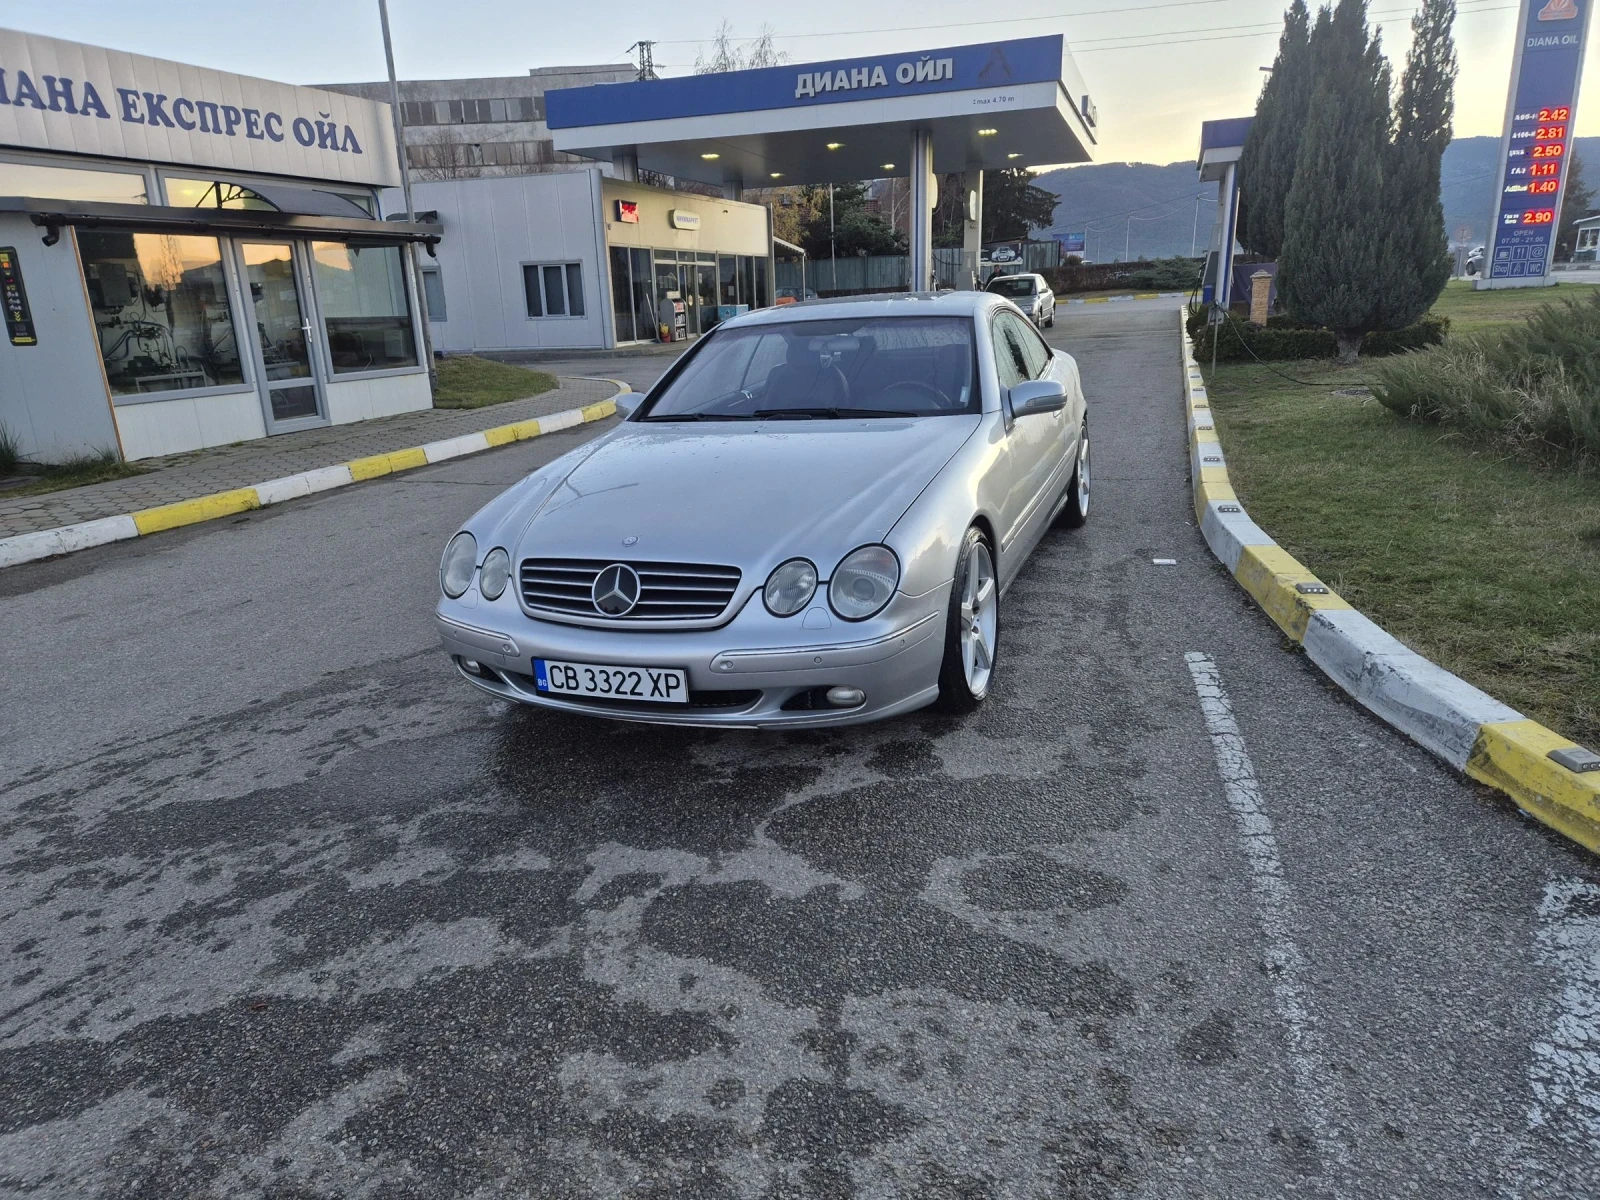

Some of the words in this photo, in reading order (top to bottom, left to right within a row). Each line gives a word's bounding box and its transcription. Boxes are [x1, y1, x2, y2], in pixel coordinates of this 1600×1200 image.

[1527, 36, 1559, 47] DIANA
[1561, 34, 1579, 45] OIL
[795, 65, 889, 98] ДИАНА
[895, 55, 953, 84] ОЙЛ
[116, 87, 285, 142] ЕКСПРЕС
[292, 110, 363, 154] ОЙЛ
[1538, 109, 1568, 121] 2.42
[1536, 127, 1563, 139] 2.81
[1533, 145, 1562, 157] 2.50
[1529, 163, 1556, 176] 1.11
[1528, 181, 1557, 193] 1.40
[1523, 211, 1552, 223] 2.90
[1513, 229, 1534, 237] OPEN
[1494, 265, 1508, 275] Shop
[1529, 263, 1541, 273] WC
[537, 678, 548, 687] BG
[549, 664, 579, 691] CB
[584, 668, 643, 696] 3322
[647, 671, 681, 698] XP
